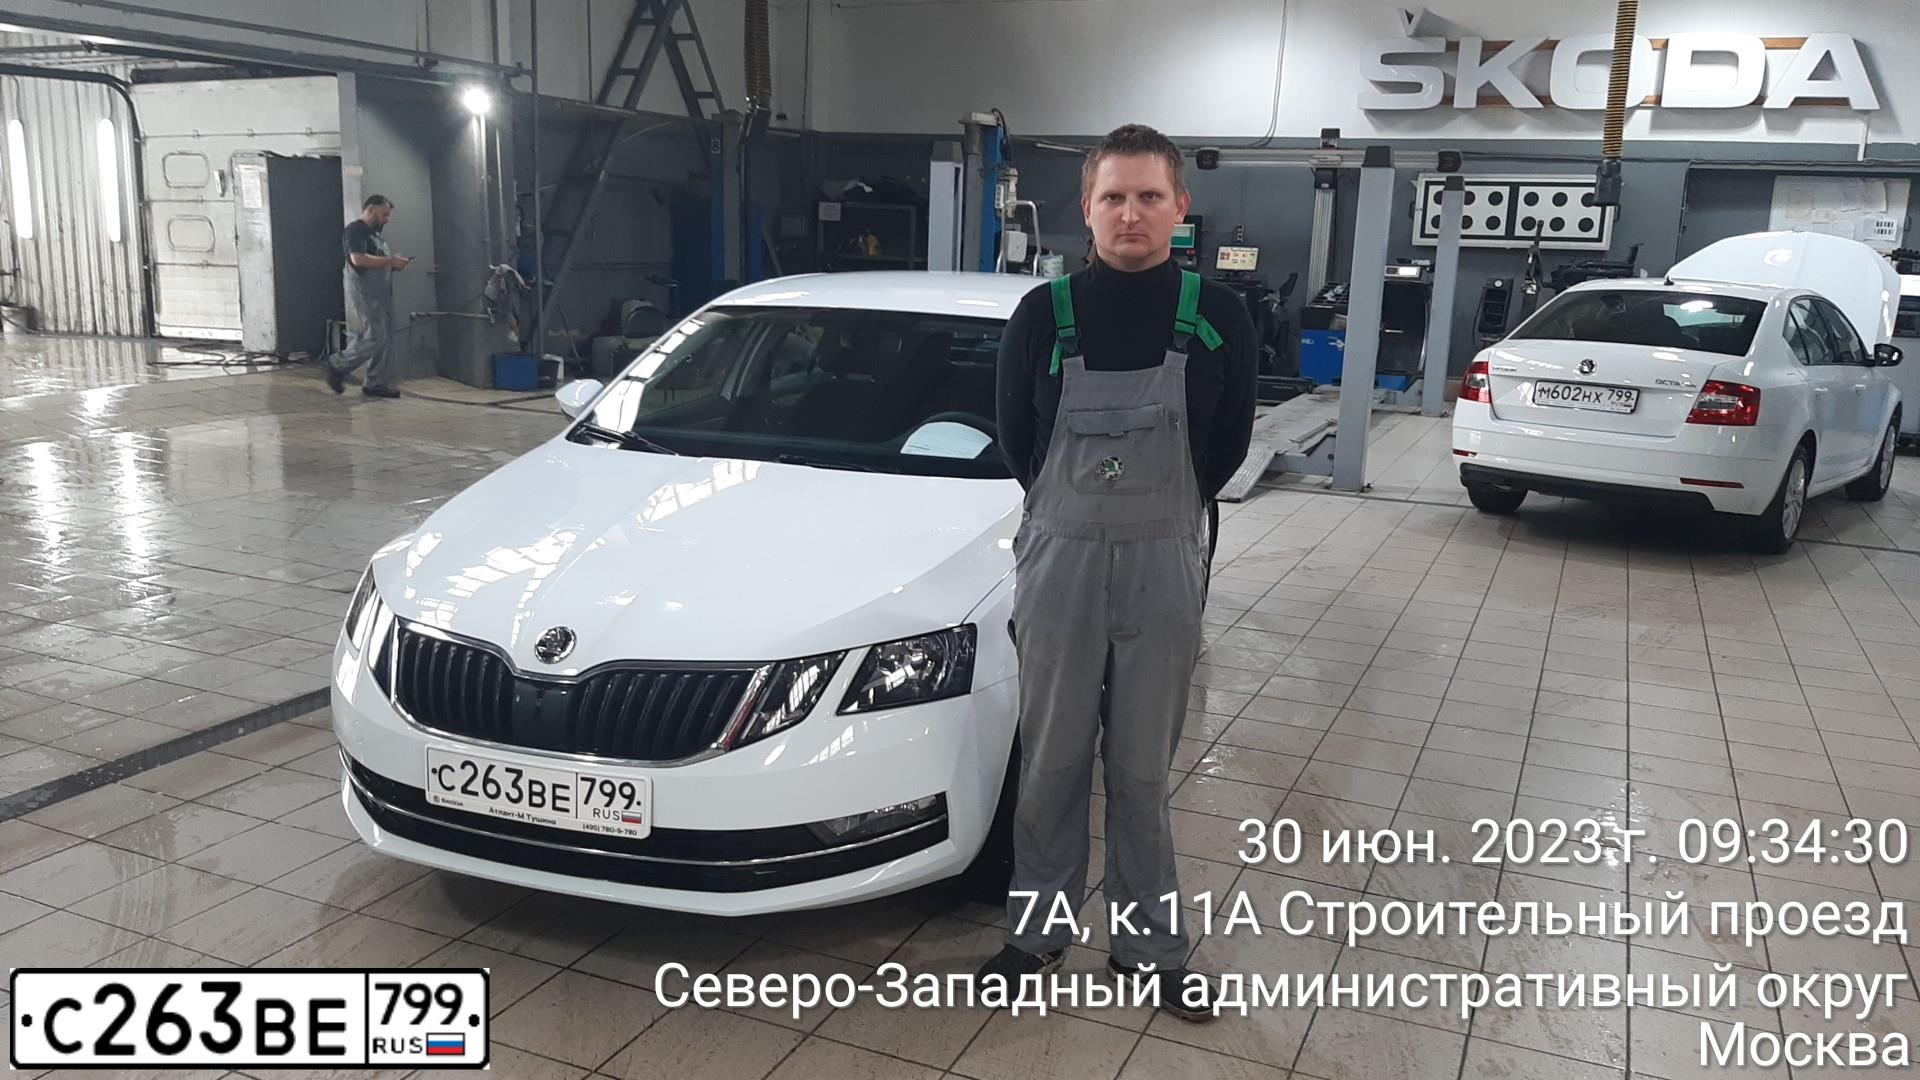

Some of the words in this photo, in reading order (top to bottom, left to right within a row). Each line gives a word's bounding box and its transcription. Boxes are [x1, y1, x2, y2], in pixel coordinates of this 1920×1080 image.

[1357, 7, 1881, 110] ŠKODA
[1655, 378, 1697, 389] OCTA
[1607, 388, 1632, 402] 799
[579, 776, 637, 811] 799
[592, 807, 621, 821] RUS
